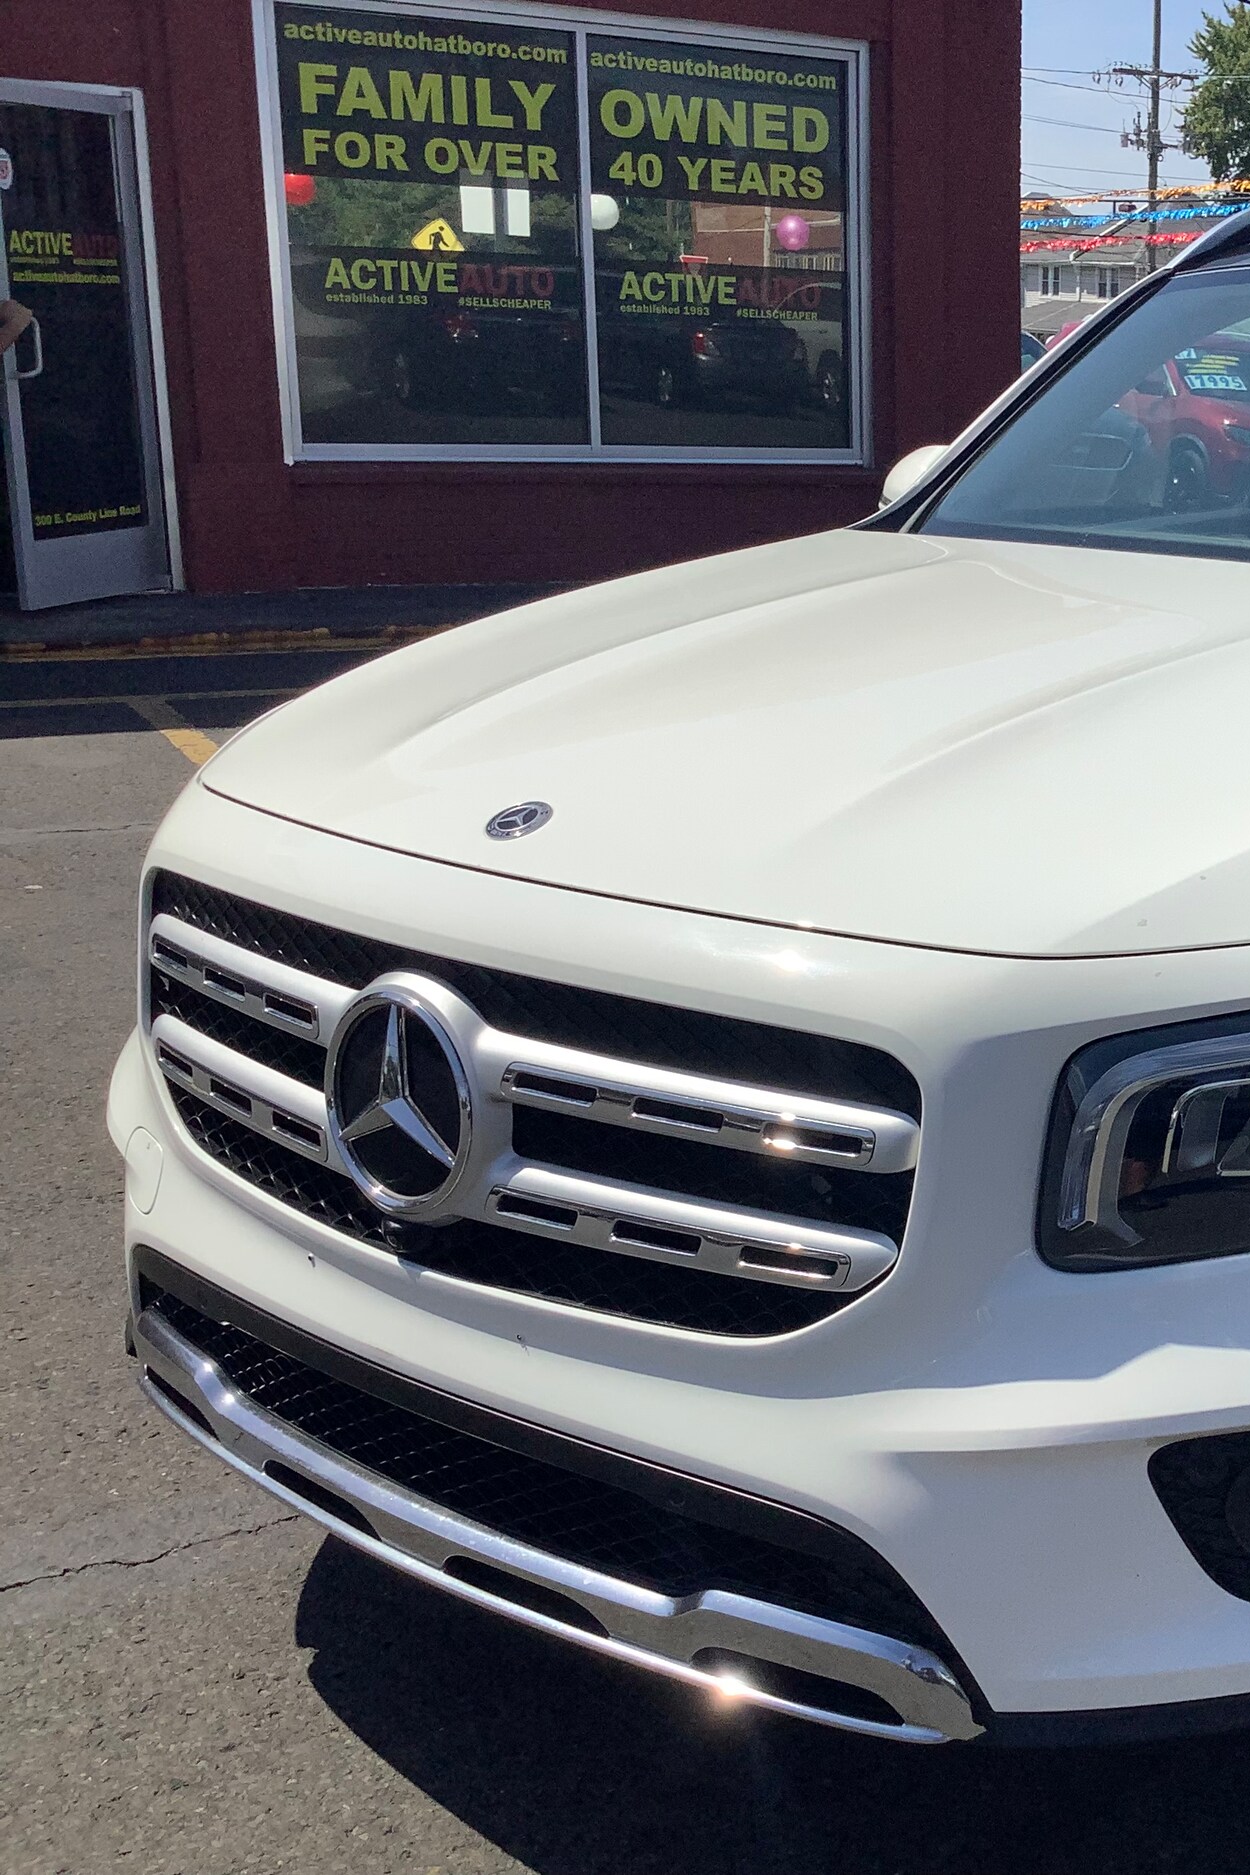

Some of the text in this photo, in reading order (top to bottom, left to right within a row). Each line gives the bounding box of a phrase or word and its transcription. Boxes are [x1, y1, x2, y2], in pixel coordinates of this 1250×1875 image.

[283, 21, 567, 64] activeautohatboro.com
[590, 50, 837, 90] activeautohatboro.com
[298, 61, 557, 132] FAMILY
[600, 88, 830, 154] OWNED
[302, 128, 560, 182] FOR OVER
[608, 151, 825, 200] 40 YEARS
[325, 292, 428, 305] established 1983
[620, 303, 710, 317] established 1983
[1188, 374, 1243, 388] 17995
[66, 510, 97, 522] County
